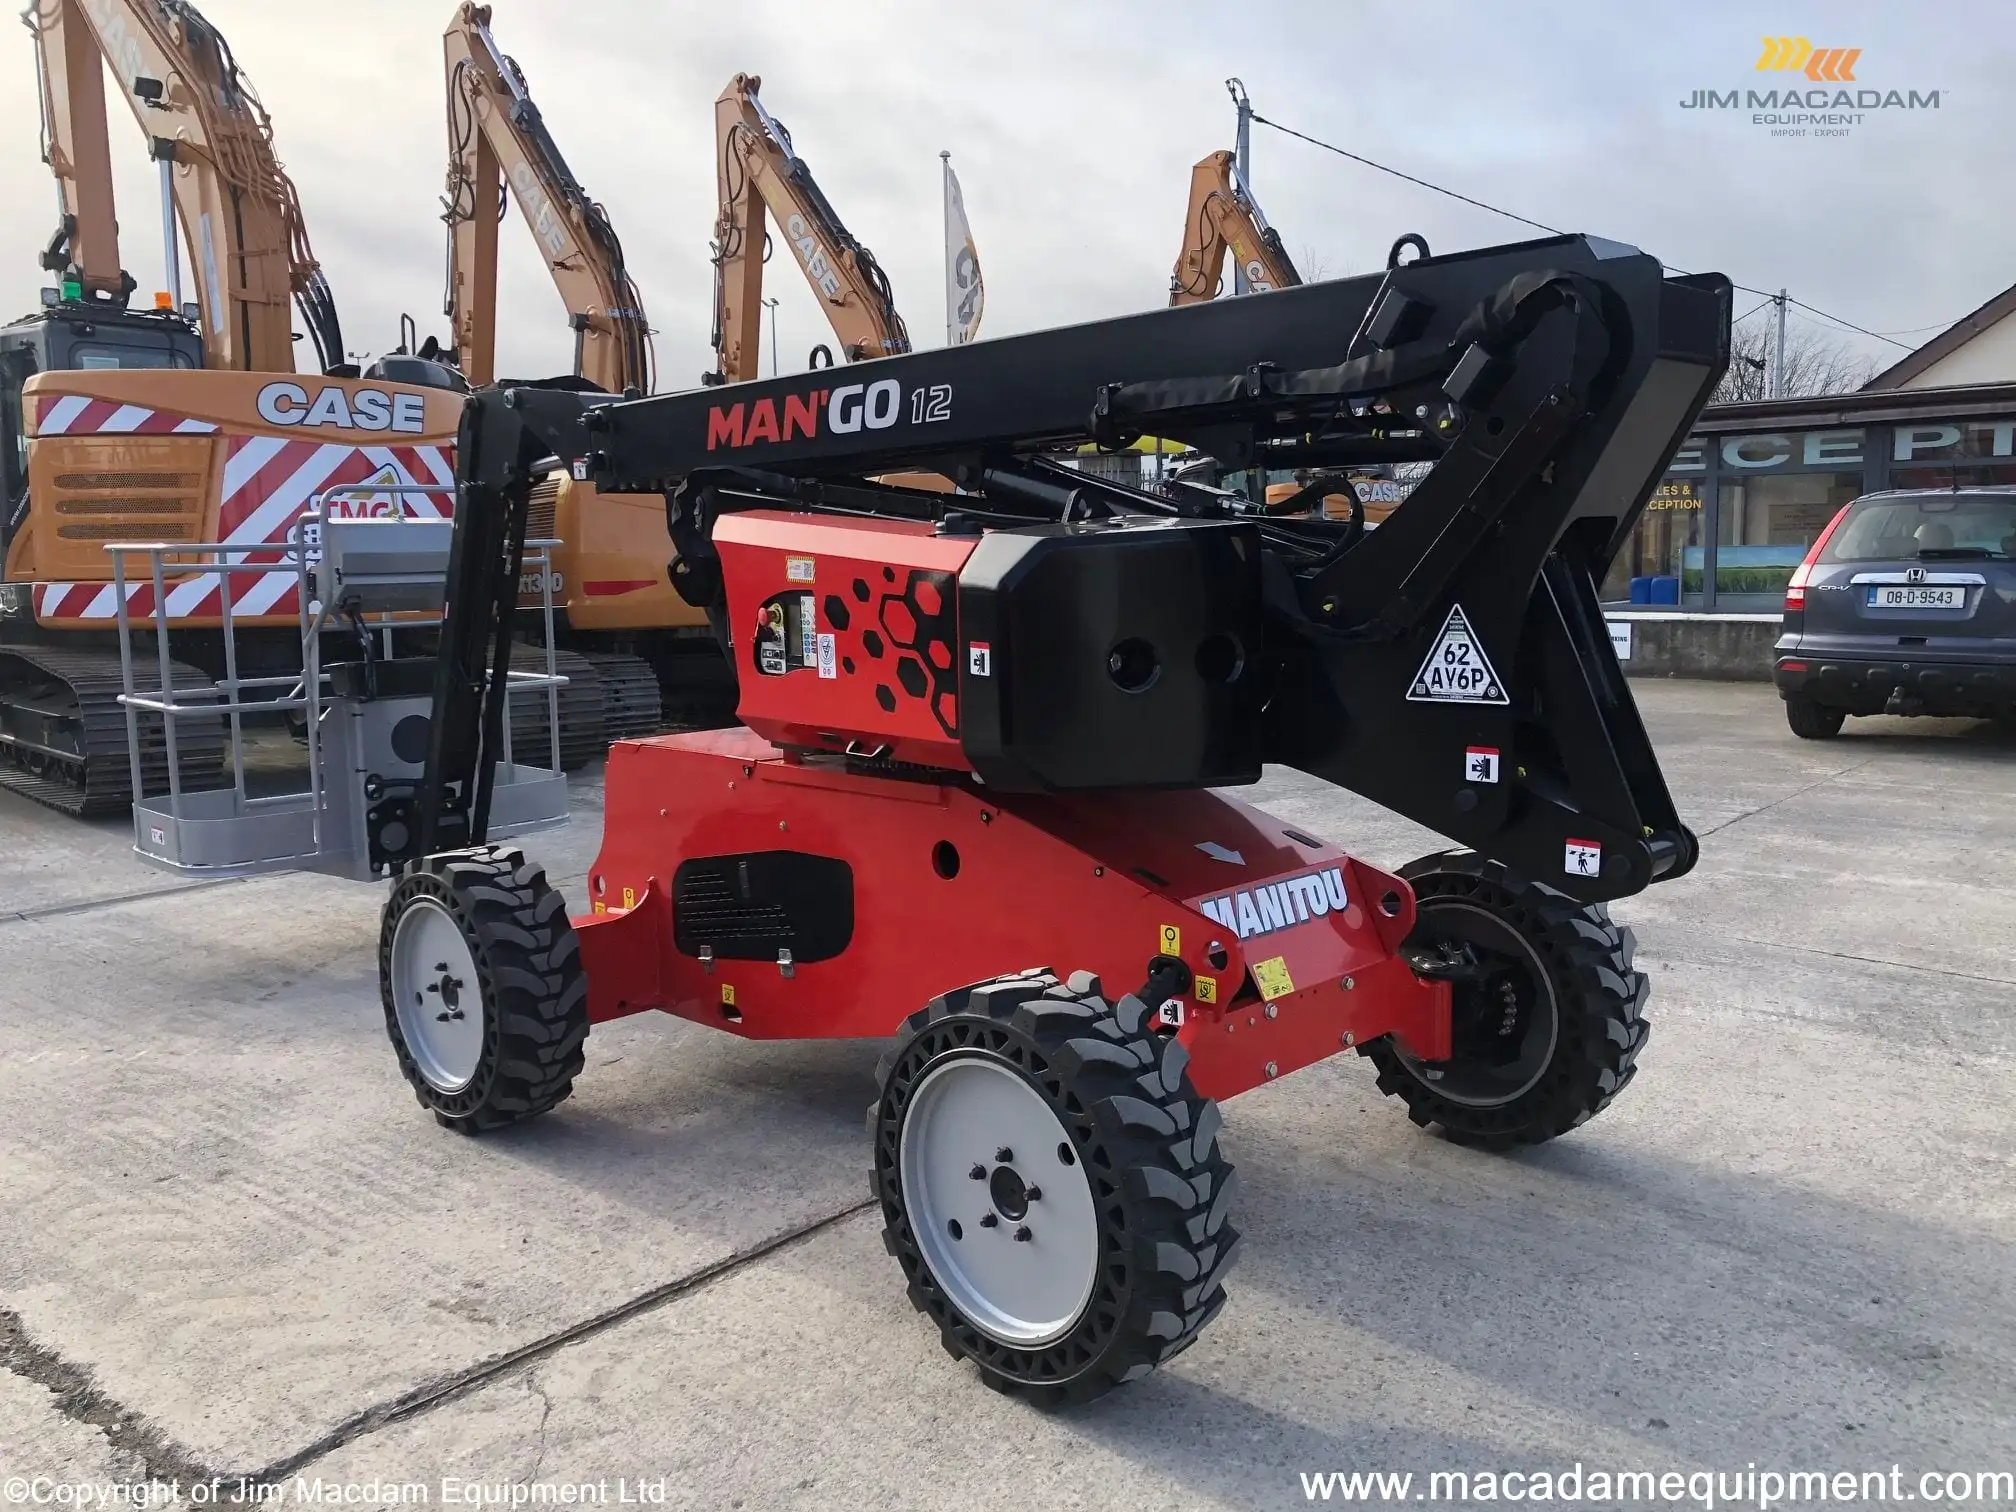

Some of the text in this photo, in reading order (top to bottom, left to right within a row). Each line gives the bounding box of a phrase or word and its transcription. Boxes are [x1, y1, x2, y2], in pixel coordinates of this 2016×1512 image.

[513, 160, 566, 257] CASE
[787, 213, 841, 299] CASE
[256, 381, 424, 434] CASE
[707, 378, 953, 450] MAN'GO 12
[1669, 422, 2016, 471] ECEPT
[1355, 482, 1399, 503] CASE
[1648, 499, 1702, 510] CEPTION
[1656, 485, 1691, 496] LES &
[1886, 590, 1953, 605] 08-D-9543
[1444, 643, 1470, 666] 62
[1431, 667, 1484, 690] AY6P
[1201, 868, 1348, 939] MANITOU
